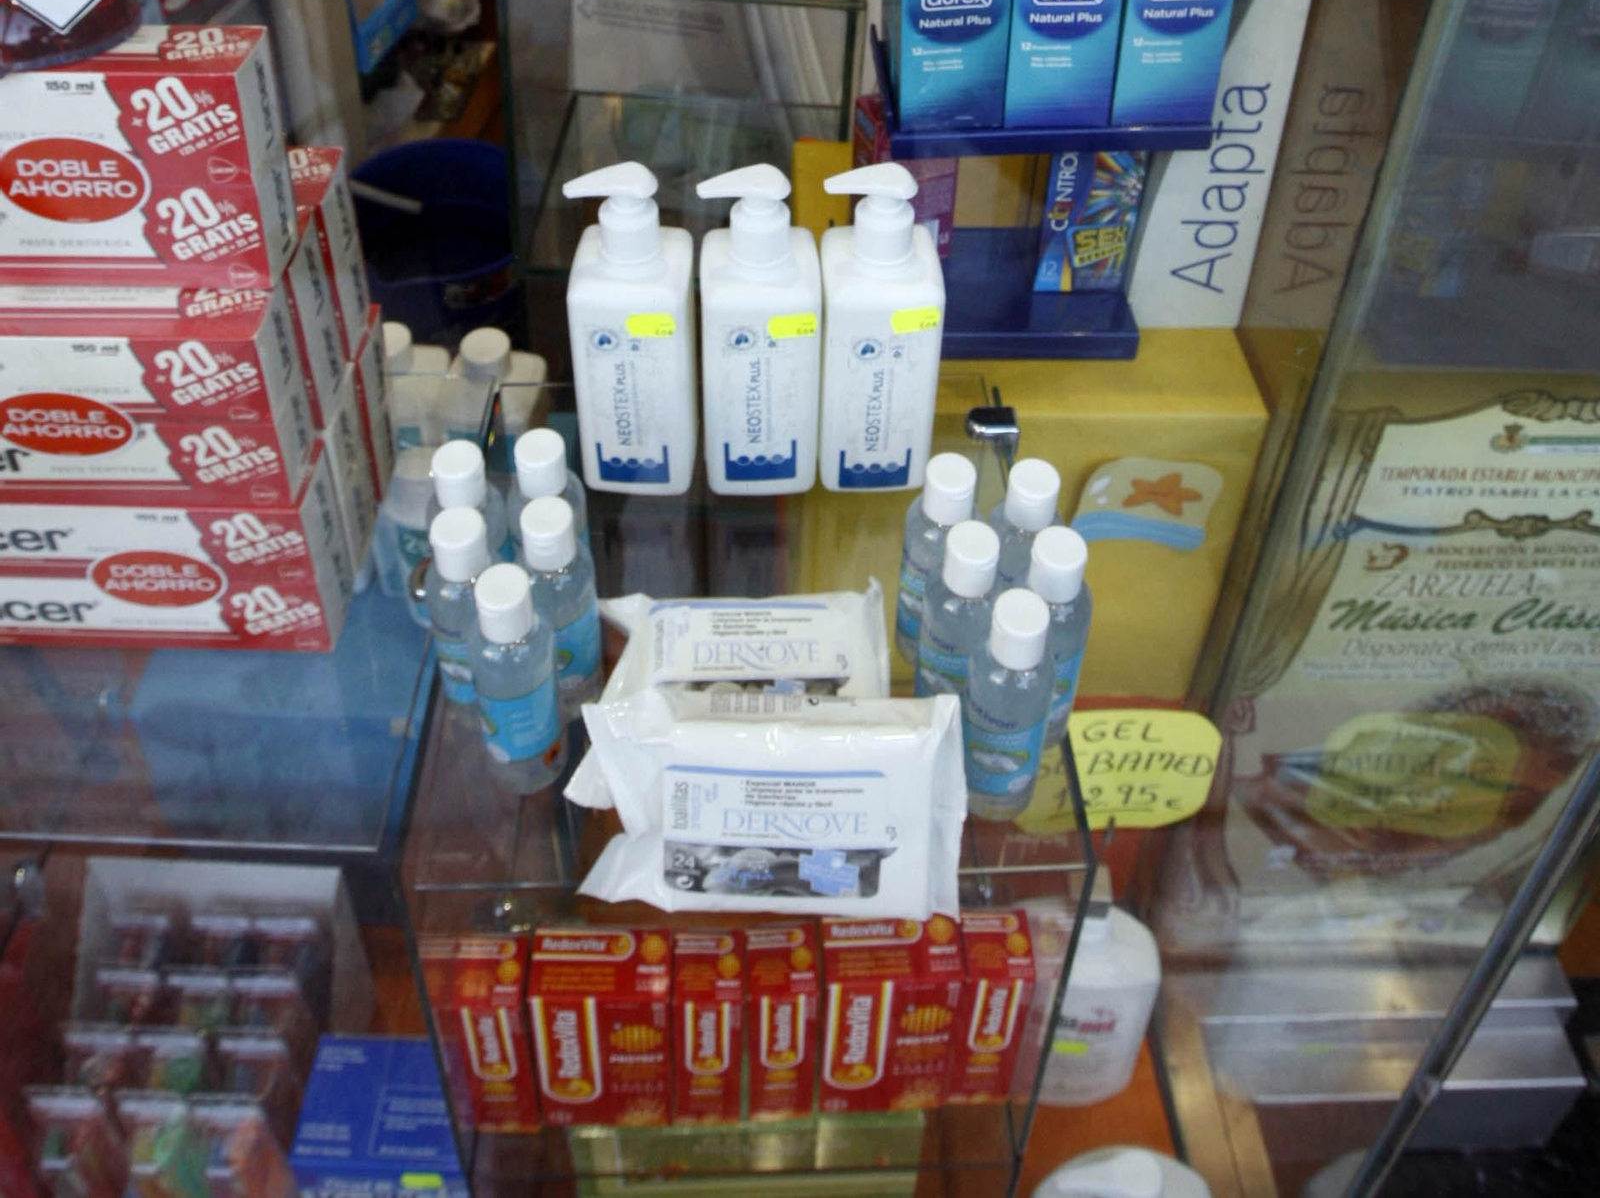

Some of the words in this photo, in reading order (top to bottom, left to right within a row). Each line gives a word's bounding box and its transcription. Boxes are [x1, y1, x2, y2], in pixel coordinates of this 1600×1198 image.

[919, 16, 964, 29] Natural
[966, 14, 992, 26] Plus
[1029, 12, 1075, 23] Natural
[1078, 12, 1103, 23] Plus
[1143, 7, 1186, 20] Natural
[1189, 6, 1214, 18] Plus
[166, 39, 252, 60] GRATIS
[147, 103, 238, 155] GRATIS
[15, 158, 120, 178] DOBLE
[9, 178, 138, 199] AHORRO
[1047, 151, 1079, 232] CONTRO
[1171, 81, 1271, 294] Adapta
[171, 212, 259, 261] GRATIS
[186, 289, 269, 318] GRATIS
[171, 361, 258, 406] GRATIS
[6, 407, 109, 424] DOBLE
[614, 386, 633, 447] NEOSTEX
[746, 385, 763, 444] NEOSTEX
[865, 395, 883, 452] NEOSTEX
[1, 423, 126, 440] AHORRO
[196, 445, 278, 484] GRATIS
[1381, 466, 1468, 481] TEMPORADA
[1471, 466, 1531, 481] ESTABLE
[1403, 486, 1474, 497] TEATRO
[1479, 486, 1540, 498] ISABEL
[1547, 486, 1570, 497] LA
[225, 531, 304, 565] GRATIS
[109, 563, 199, 578] DOBLE
[105, 578, 216, 592] AHORRO
[1376, 572, 1536, 599] ZARZUELA
[0, 601, 94, 624] cer
[244, 602, 320, 636] GRATIS
[1328, 599, 1478, 633] Música
[693, 639, 820, 668] DERNOVE
[1082, 720, 1163, 743] GEL
[722, 808, 869, 838] DERNOVE
[673, 853, 695, 868] 24
